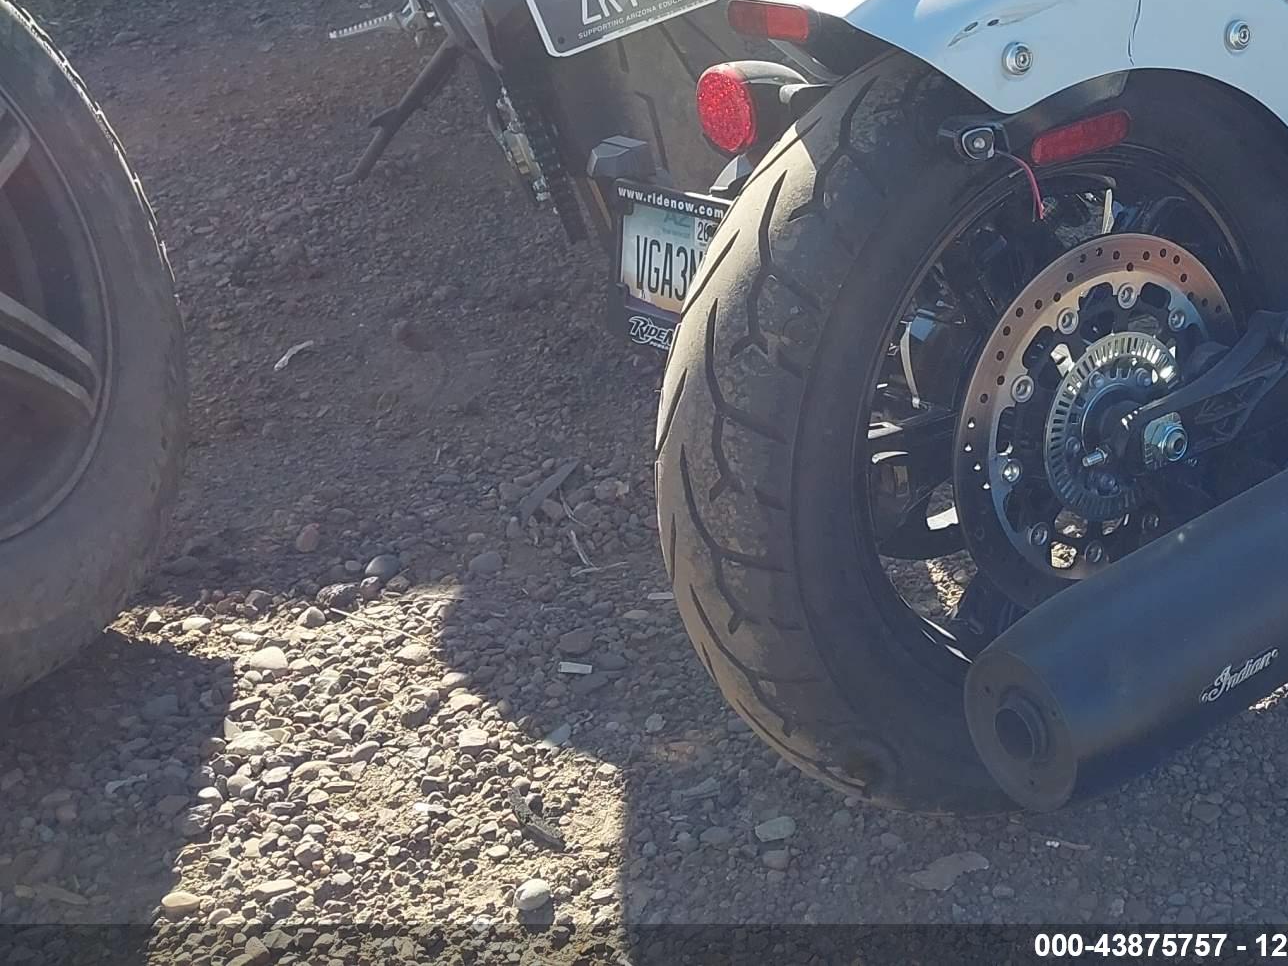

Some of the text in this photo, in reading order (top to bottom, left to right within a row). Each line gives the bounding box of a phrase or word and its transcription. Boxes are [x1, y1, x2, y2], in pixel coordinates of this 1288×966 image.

[578, 17, 625, 40] SUPPORTING
[626, 4, 657, 21] ARIZONA
[617, 185, 724, 220] www.ridenow.com
[1201, 648, 1279, 703] Indian
